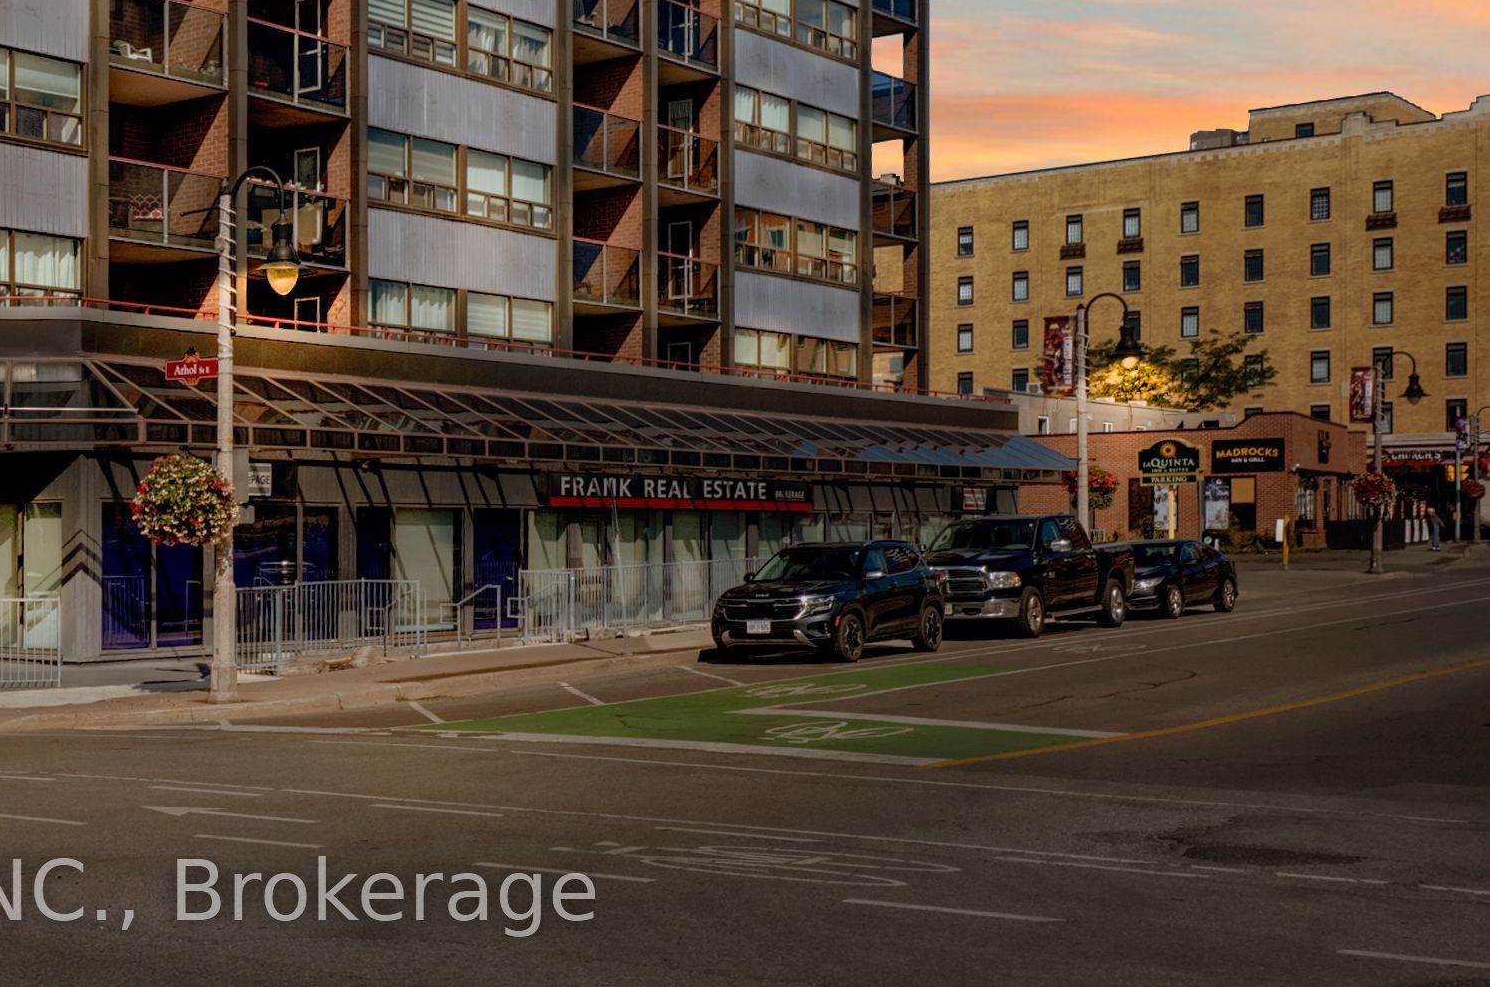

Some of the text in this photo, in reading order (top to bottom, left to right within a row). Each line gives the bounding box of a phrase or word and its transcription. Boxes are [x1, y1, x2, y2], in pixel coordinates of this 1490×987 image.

[173, 364, 197, 376] Athol
[1216, 447, 1279, 459] MADROCKS
[561, 476, 632, 498] FRANK
[643, 479, 692, 499] REAL
[703, 480, 767, 500] ESTATE
